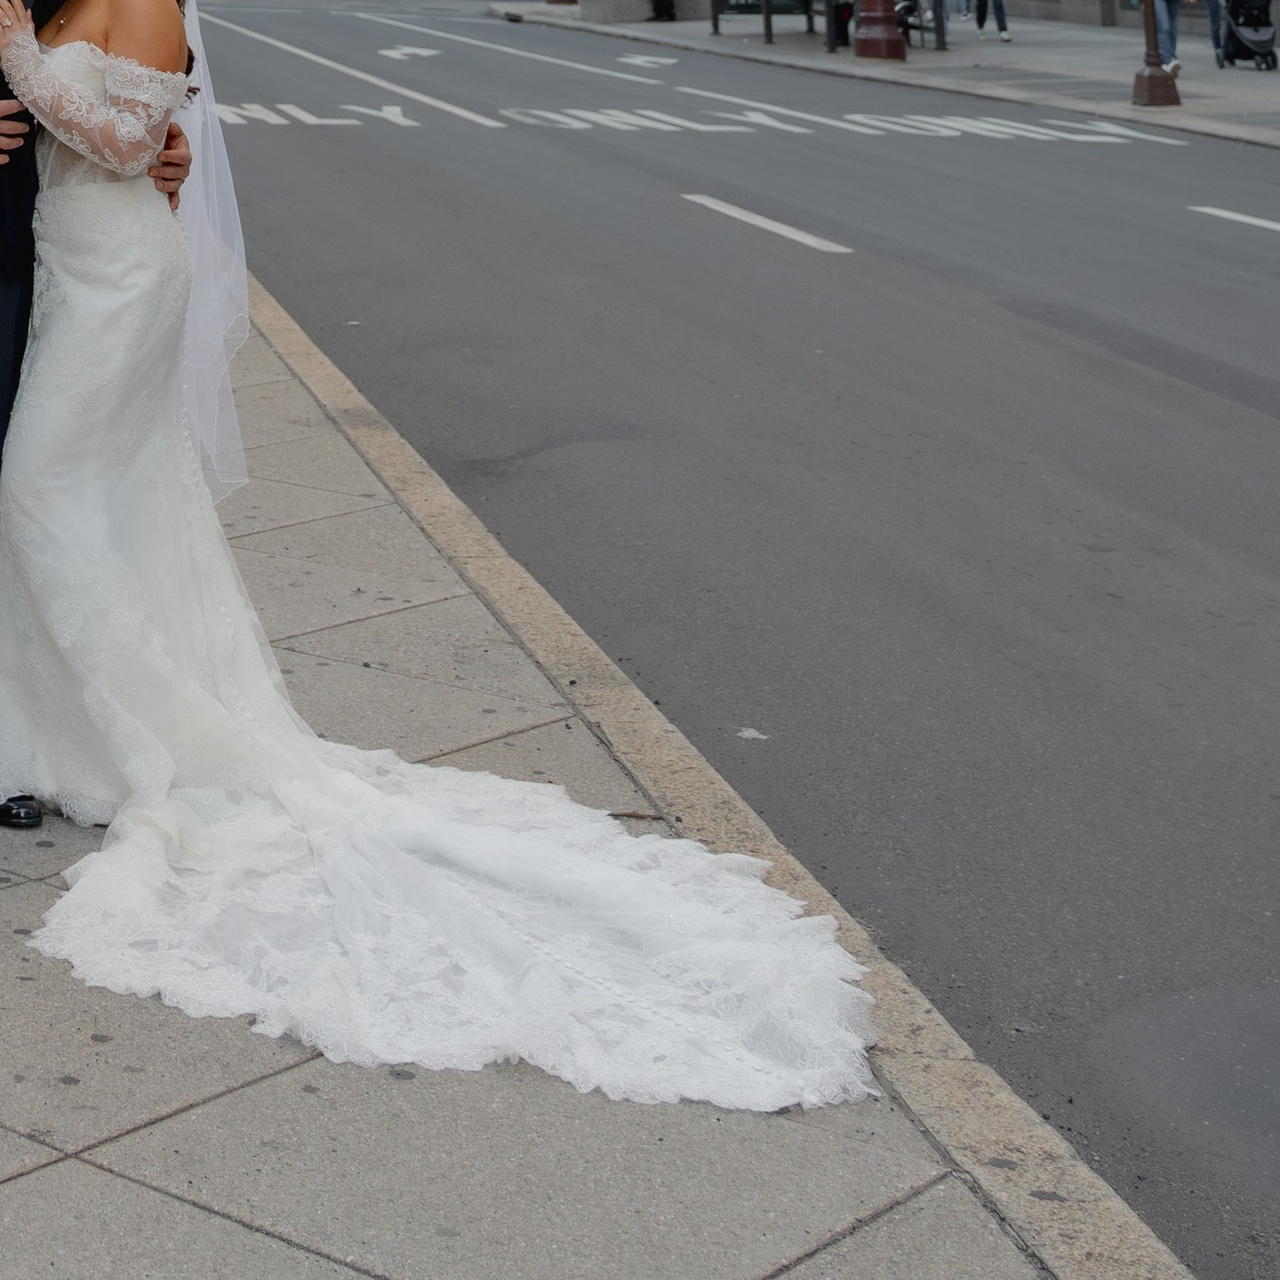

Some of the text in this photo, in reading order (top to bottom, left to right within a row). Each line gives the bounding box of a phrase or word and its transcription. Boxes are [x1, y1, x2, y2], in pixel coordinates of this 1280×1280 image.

[214, 103, 422, 127] NLY
[498, 108, 815, 133] ONLY
[843, 114, 1191, 146] ONLY
